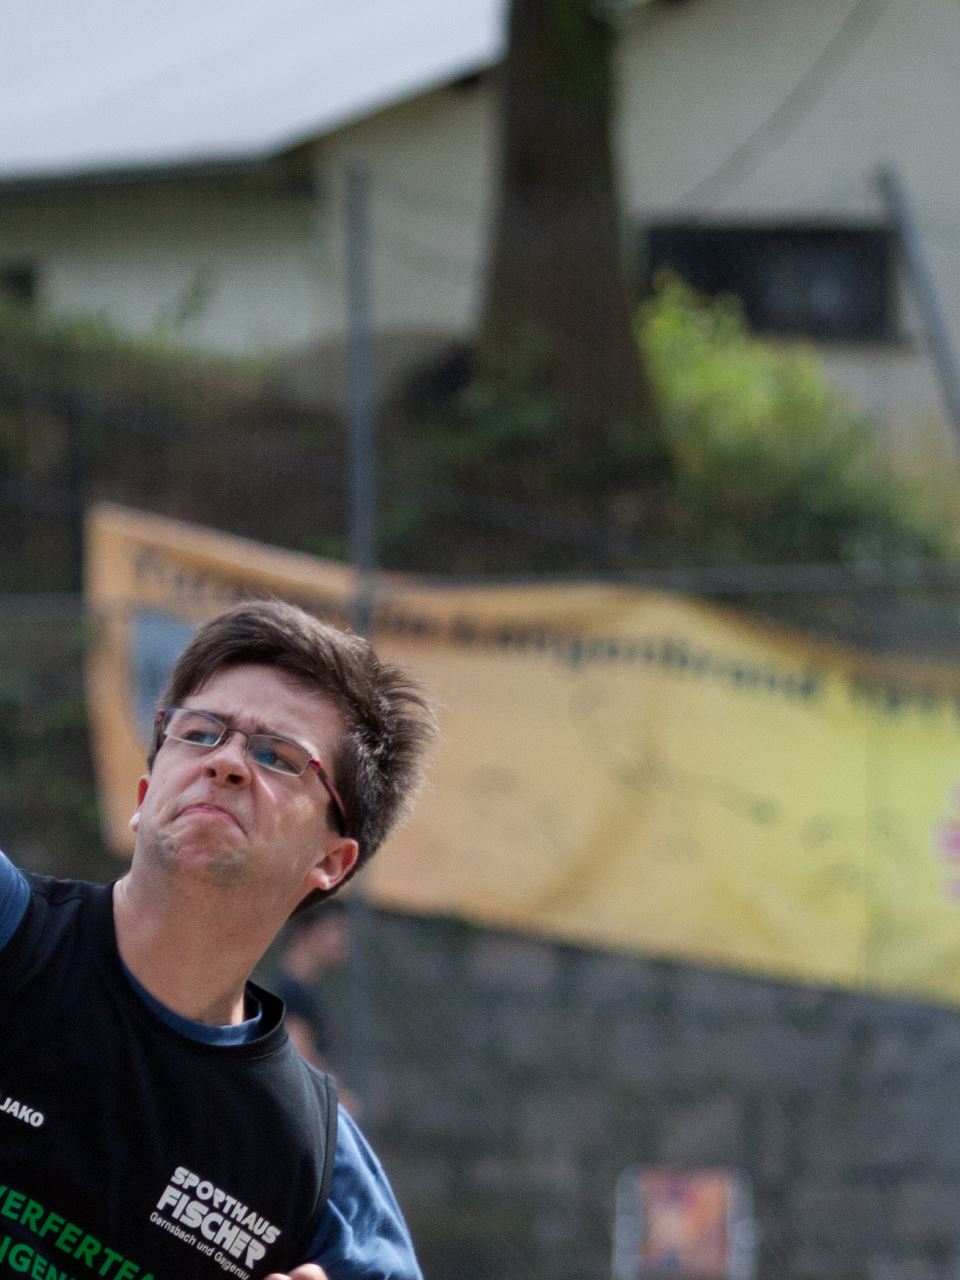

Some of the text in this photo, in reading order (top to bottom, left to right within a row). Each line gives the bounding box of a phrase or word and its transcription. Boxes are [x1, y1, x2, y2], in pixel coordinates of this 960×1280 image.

[0, 1097, 44, 1127] JAKO
[149, 1211, 197, 1246] Gernsbach
[196, 1241, 215, 1257] und
[156, 1185, 266, 1269] FISCHER
[170, 1166, 281, 1244] SPORTHAUS
